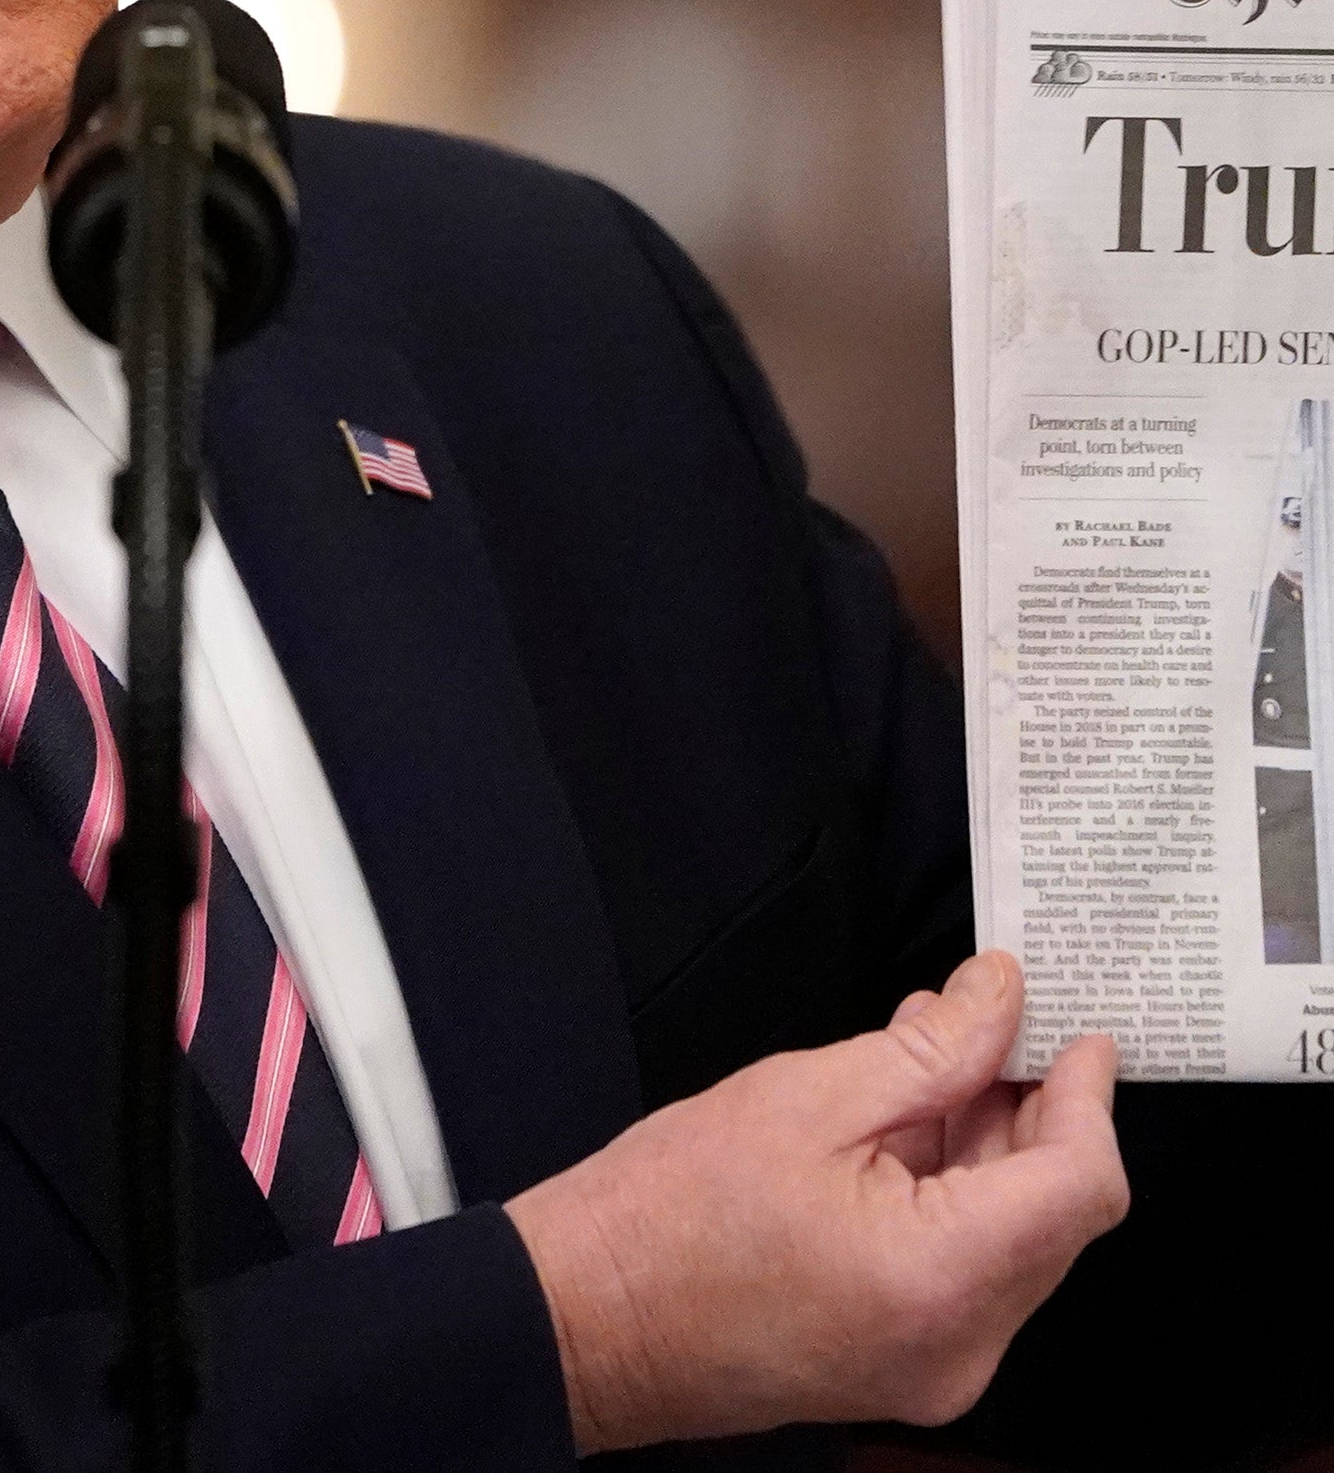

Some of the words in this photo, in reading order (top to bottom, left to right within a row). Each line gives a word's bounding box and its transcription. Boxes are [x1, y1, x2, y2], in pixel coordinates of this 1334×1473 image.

[1097, 70, 1124, 81] Rain
[1096, 331, 1267, 365] GOP-LED
[1028, 415, 1106, 431] Democrats
[1110, 415, 1124, 431] at
[1129, 419, 1137, 431] a
[1141, 415, 1196, 436] turning
[1085, 439, 1116, 454] torn
[1120, 439, 1183, 455] between
[1020, 461, 1123, 482] investigations
[1127, 462, 1155, 477] and
[1159, 462, 1202, 482] policy
